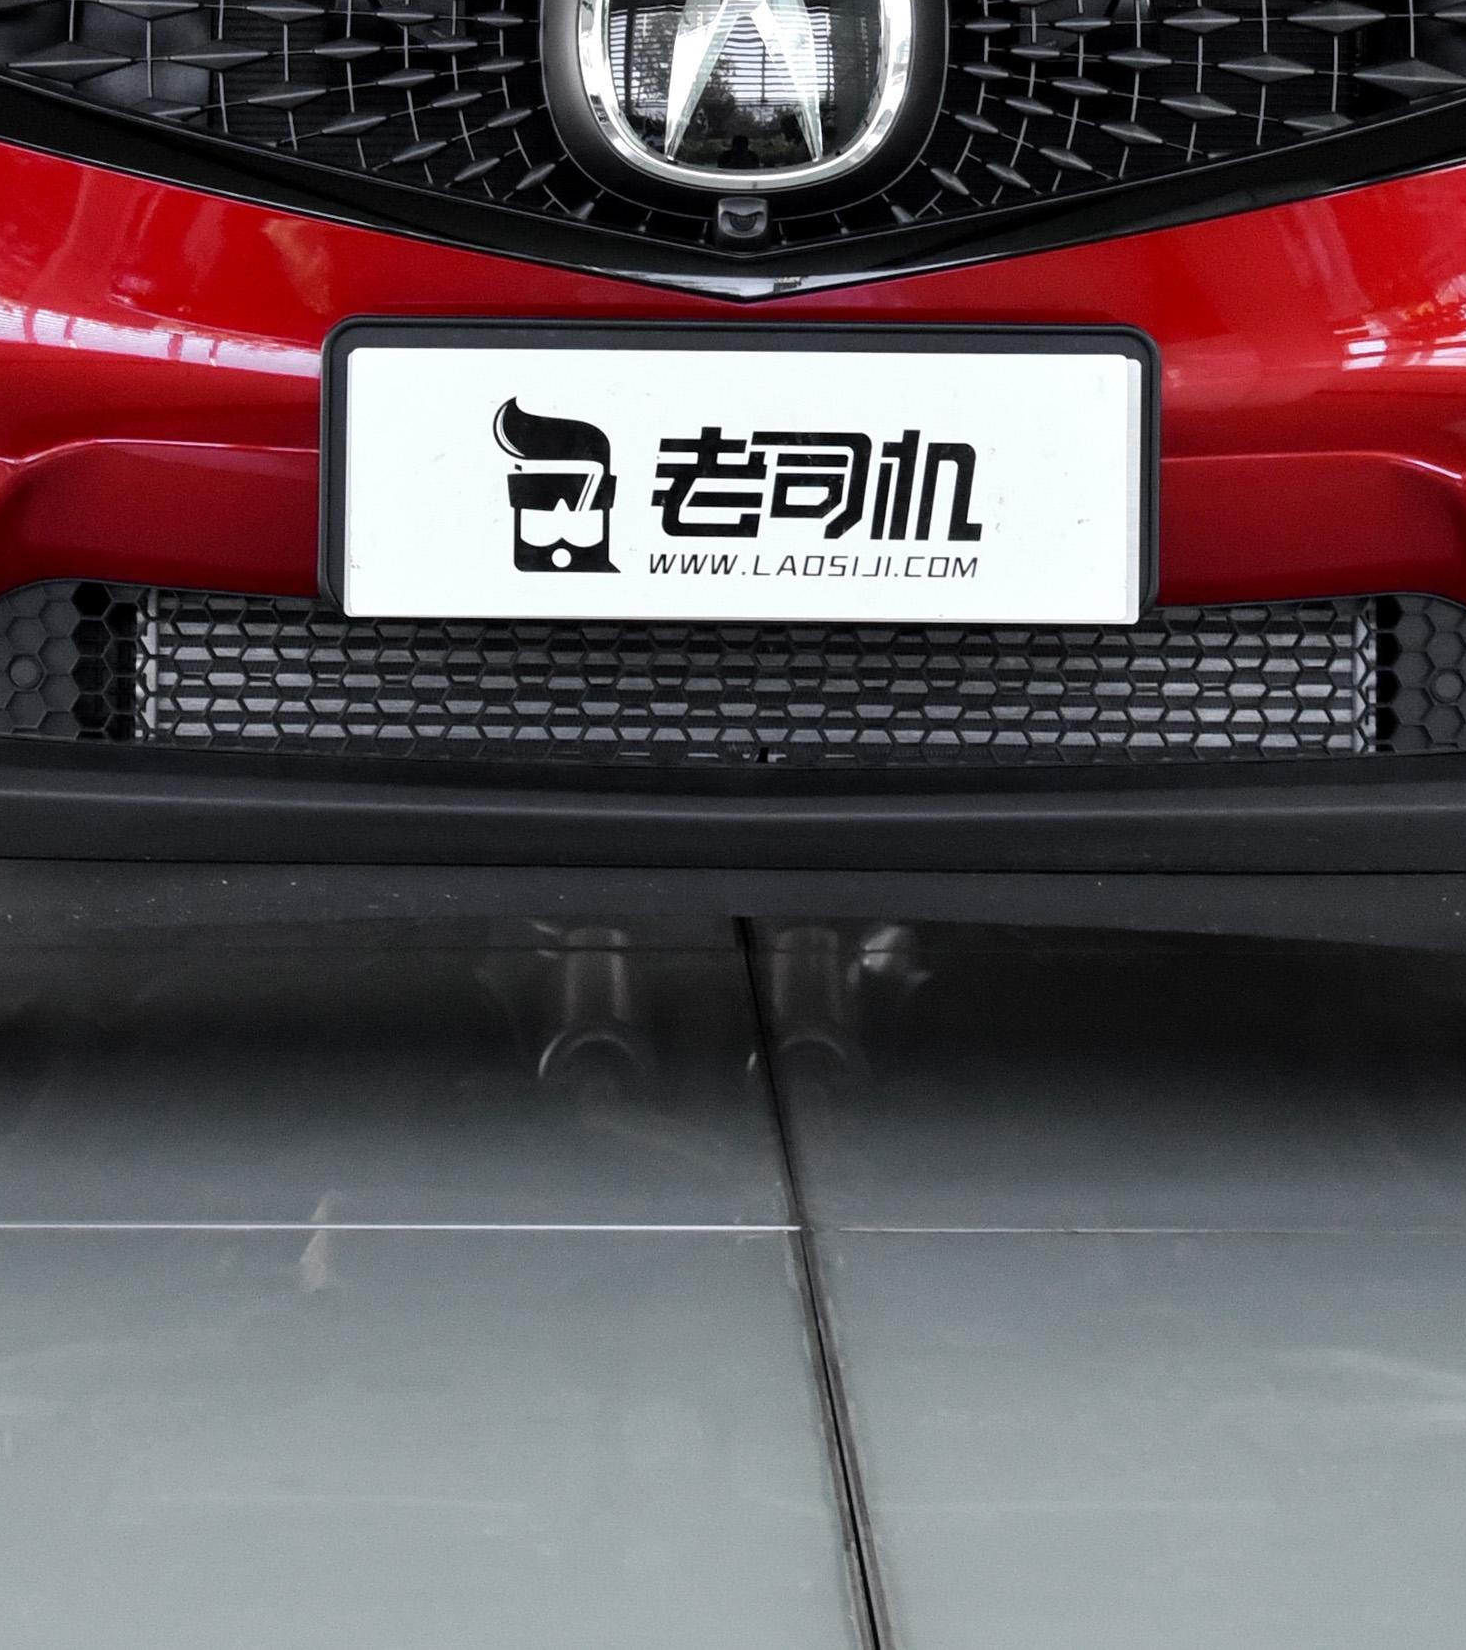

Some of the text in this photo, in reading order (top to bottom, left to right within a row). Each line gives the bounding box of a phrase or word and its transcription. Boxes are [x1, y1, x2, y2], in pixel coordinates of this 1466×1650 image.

[651, 427, 983, 541] 老司机
[649, 553, 978, 579] WWW.LAOSIJI.COM
